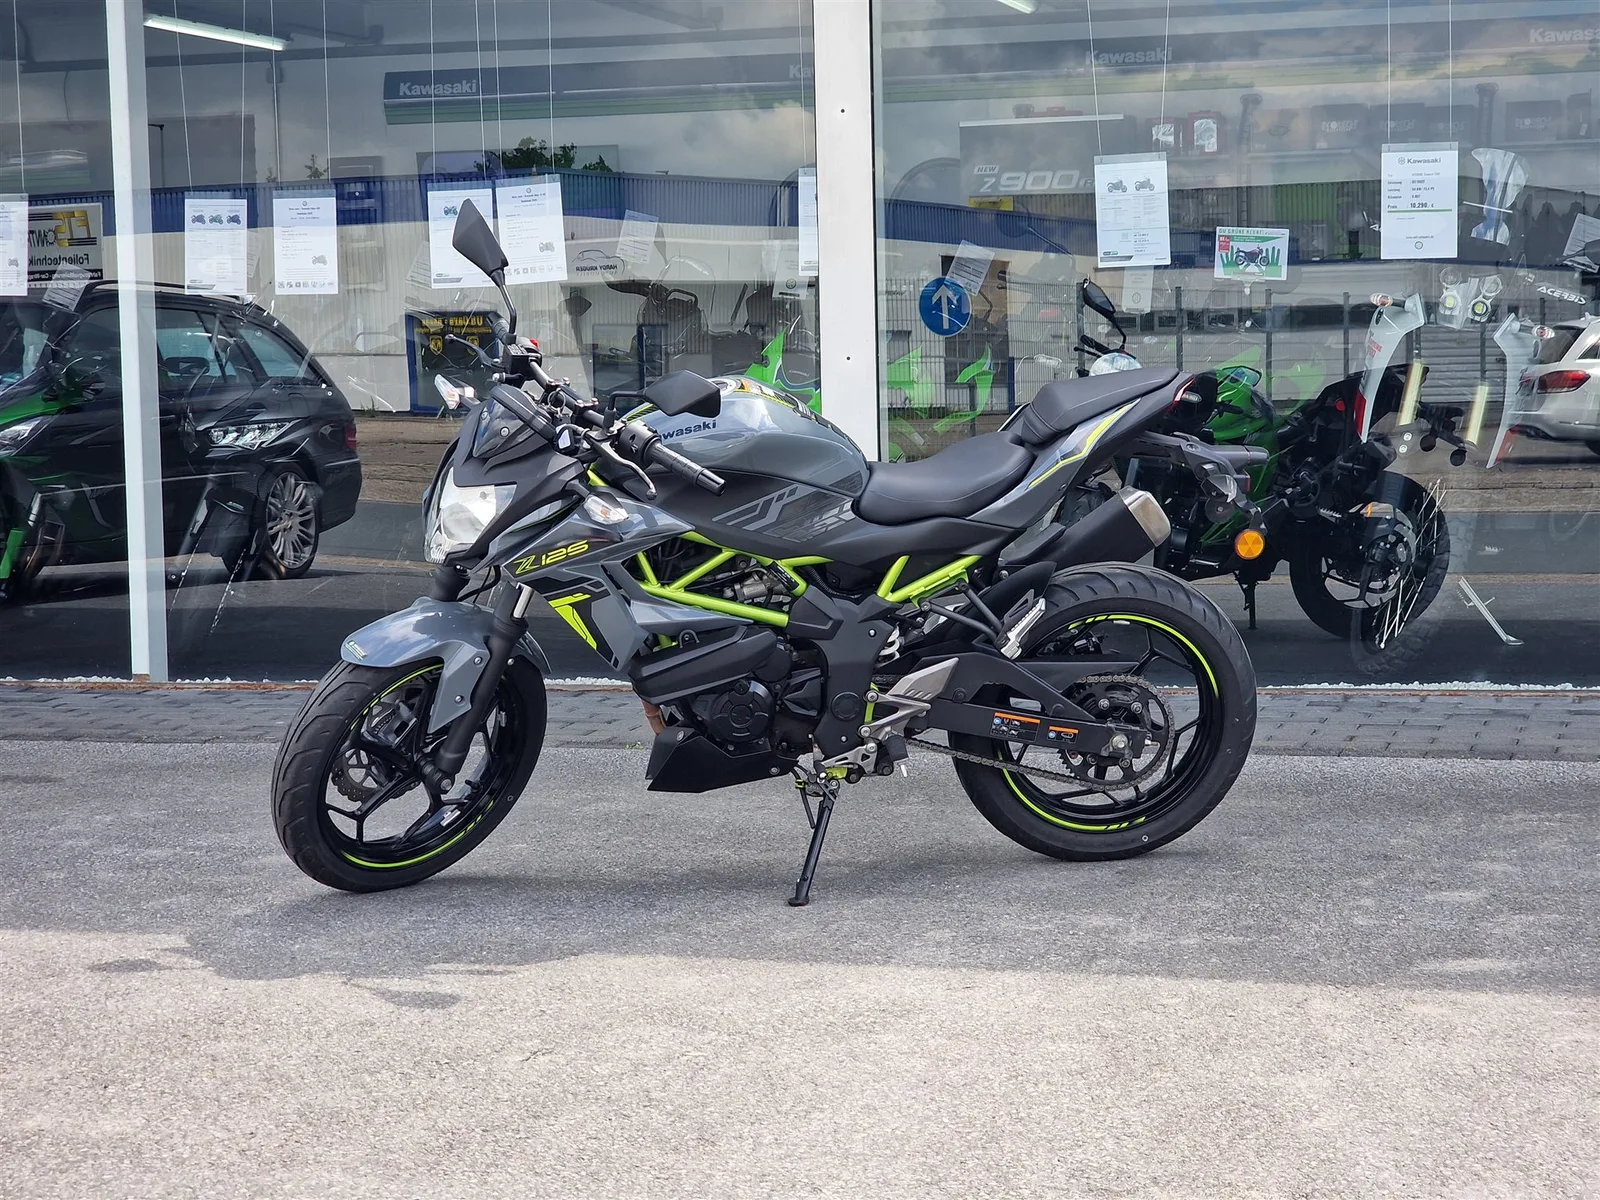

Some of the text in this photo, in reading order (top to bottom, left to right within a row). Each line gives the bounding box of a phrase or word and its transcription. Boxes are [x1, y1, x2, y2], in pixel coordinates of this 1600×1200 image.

[1085, 47, 1173, 65] Kawasaki
[399, 80, 477, 96] Kawasaki
[659, 420, 717, 440] wasaki
[513, 539, 590, 575] Z125
